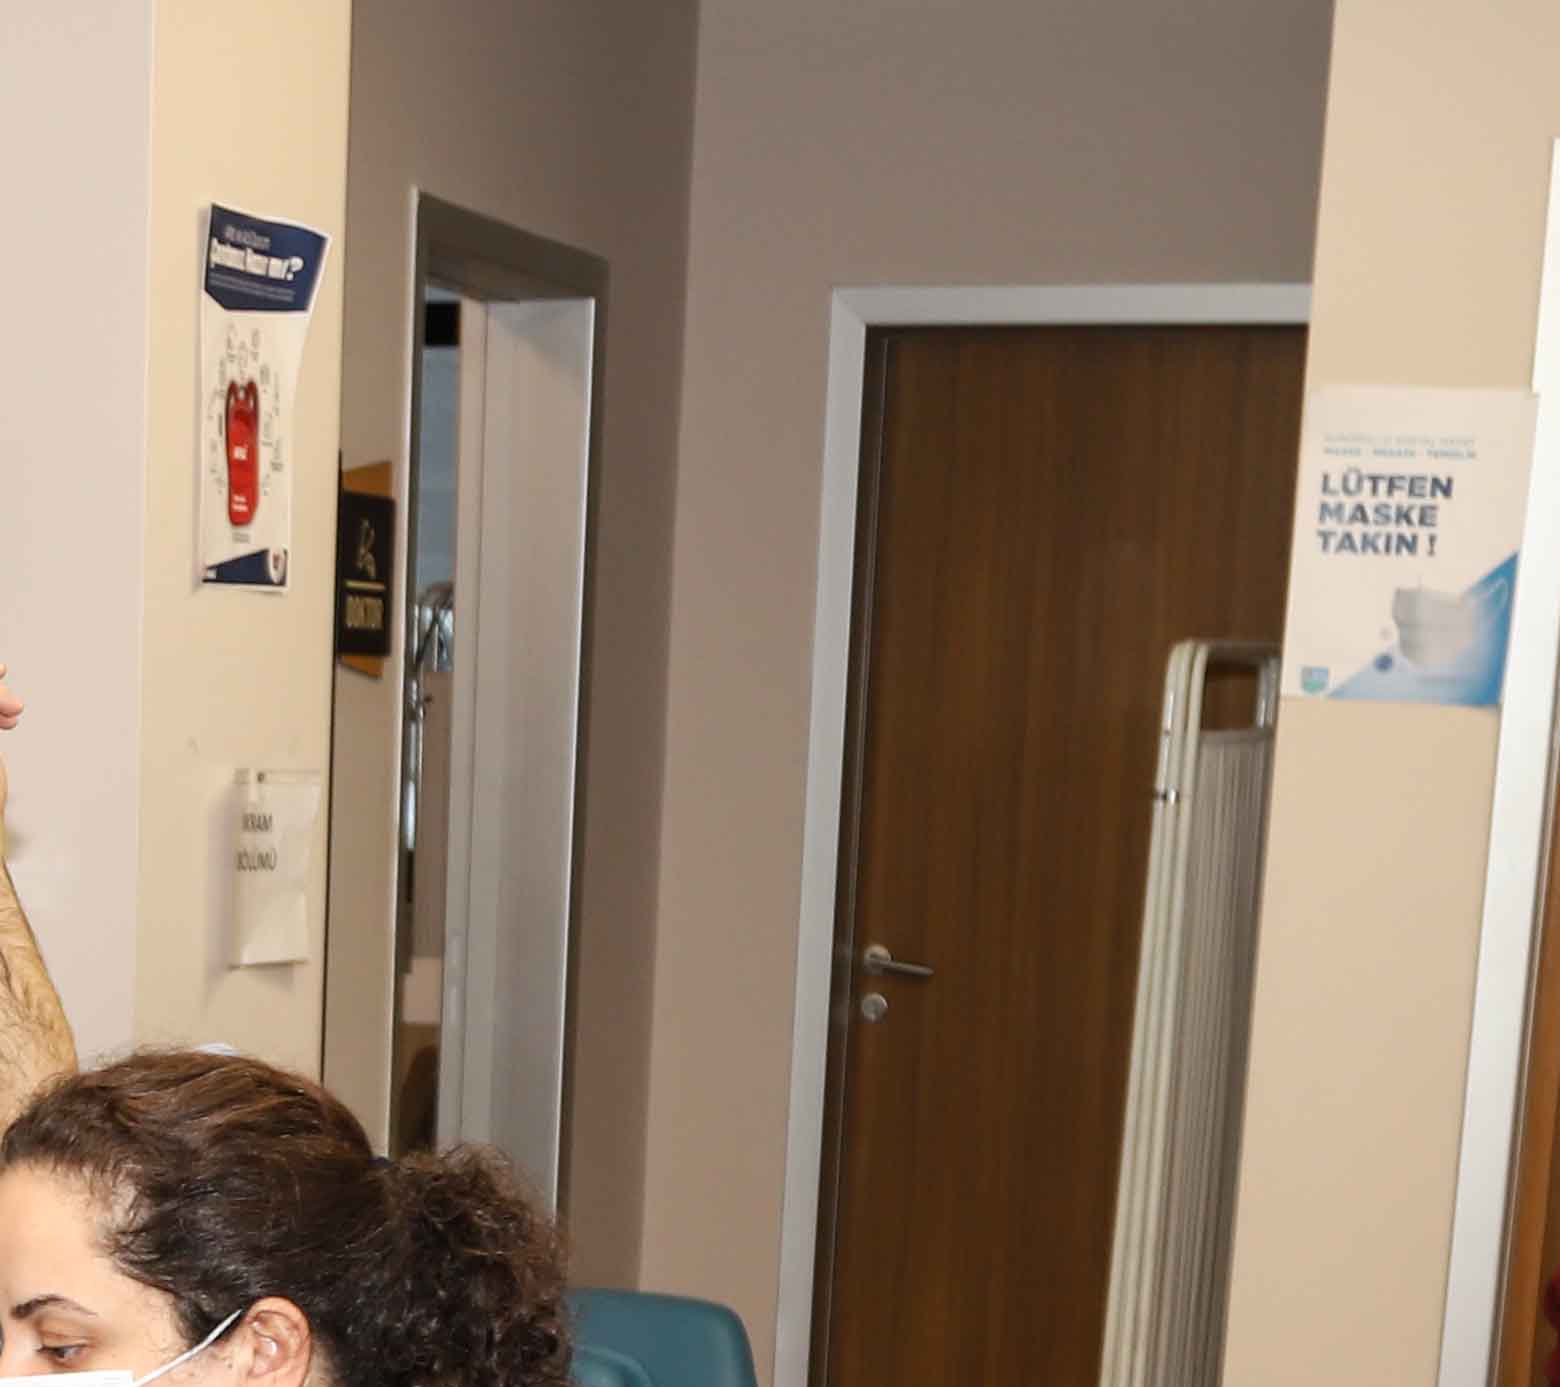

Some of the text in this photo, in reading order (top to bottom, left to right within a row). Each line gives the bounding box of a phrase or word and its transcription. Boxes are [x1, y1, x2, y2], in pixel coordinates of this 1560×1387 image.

[1321, 466, 1454, 499] LÜTFEN
[1318, 501, 1439, 527] MASKE
[1317, 529, 1419, 556] TAKIN
